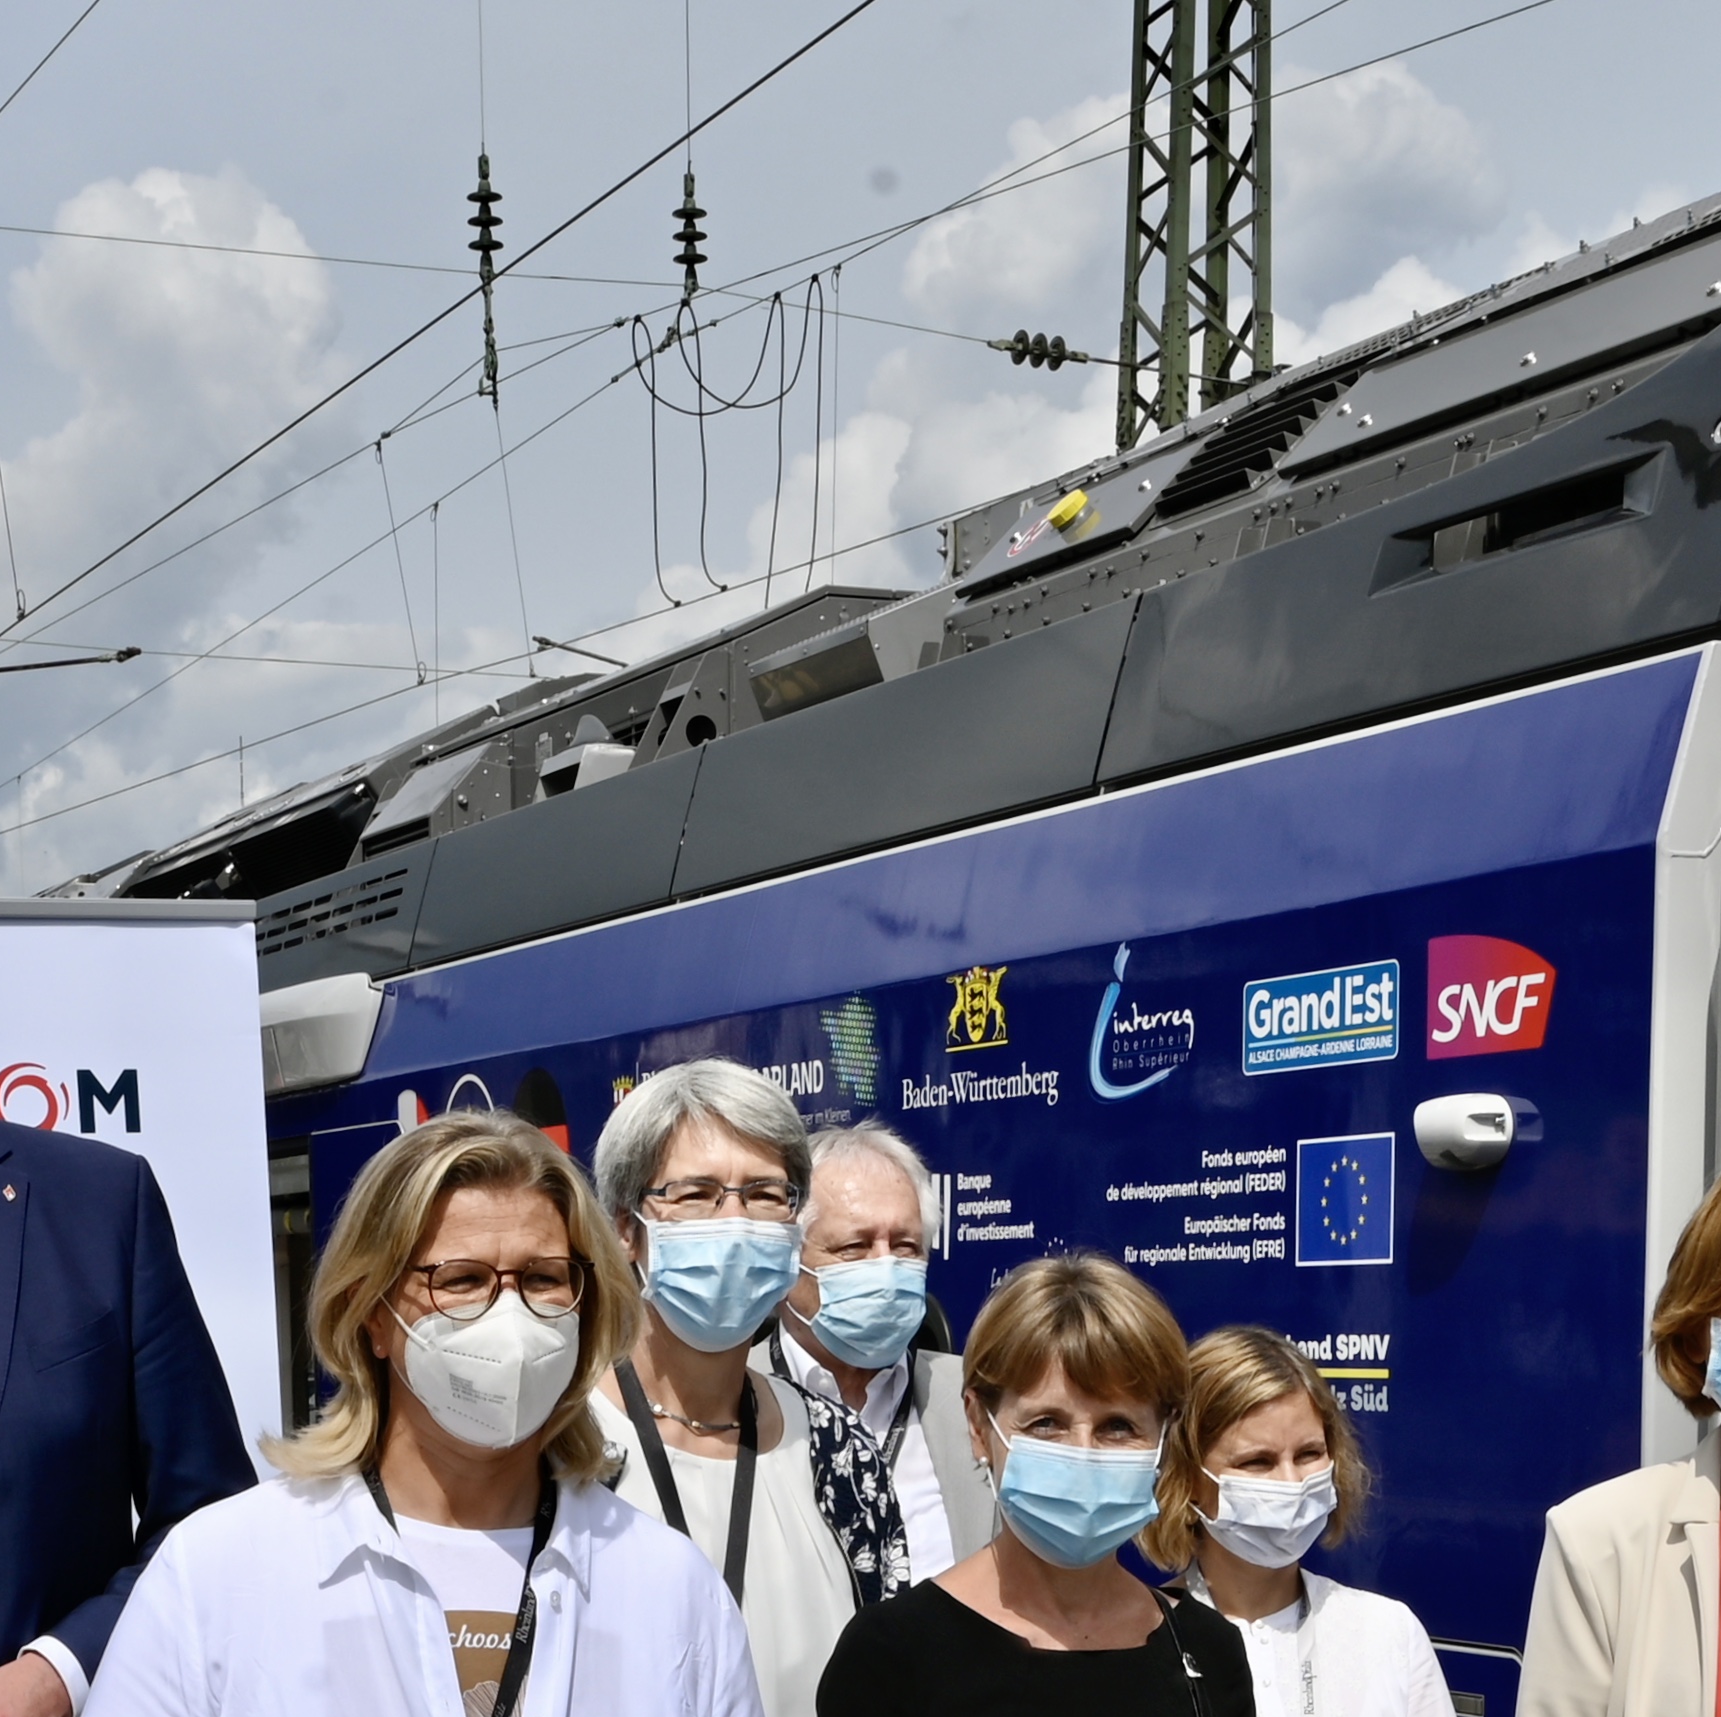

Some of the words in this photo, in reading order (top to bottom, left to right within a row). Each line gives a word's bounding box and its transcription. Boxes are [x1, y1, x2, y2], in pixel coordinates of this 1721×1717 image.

[1432, 972, 1545, 1043] SNCF
[1113, 1002, 1194, 1049] interreg
[1113, 1033, 1189, 1053] Oberrhein
[1248, 1050, 1275, 1064] ALSACE
[1276, 1039, 1355, 1060] CHAMPAGNE-ARDENNE
[1356, 1034, 1393, 1051] LORRAINE
[1113, 1057, 1133, 1070] Rhin
[1139, 1052, 1189, 1069] Supérieur
[902, 1061, 1059, 1110] Baden-Württemberg
[1202, 1149, 1233, 1168] Fonds
[1235, 1145, 1286, 1168] européen
[957, 1173, 992, 1194] Banque
[1106, 1184, 1119, 1201] de
[1121, 1178, 1198, 1202] développement
[1200, 1174, 1243, 1199] régional
[1245, 1170, 1286, 1194] (FEDER)
[957, 1196, 1012, 1220] européenne
[957, 1220, 1034, 1241] d'investissement
[1184, 1213, 1251, 1238] Europäischer
[1253, 1211, 1285, 1231] Fonds
[1124, 1245, 1138, 1263] für
[1140, 1244, 1187, 1266] regionale
[1189, 1241, 1250, 1264] Entwicklung
[1252, 1238, 1285, 1260] (EFRE)
[1335, 1334, 1390, 1361] SPNV
[1350, 1383, 1389, 1412] Süd
